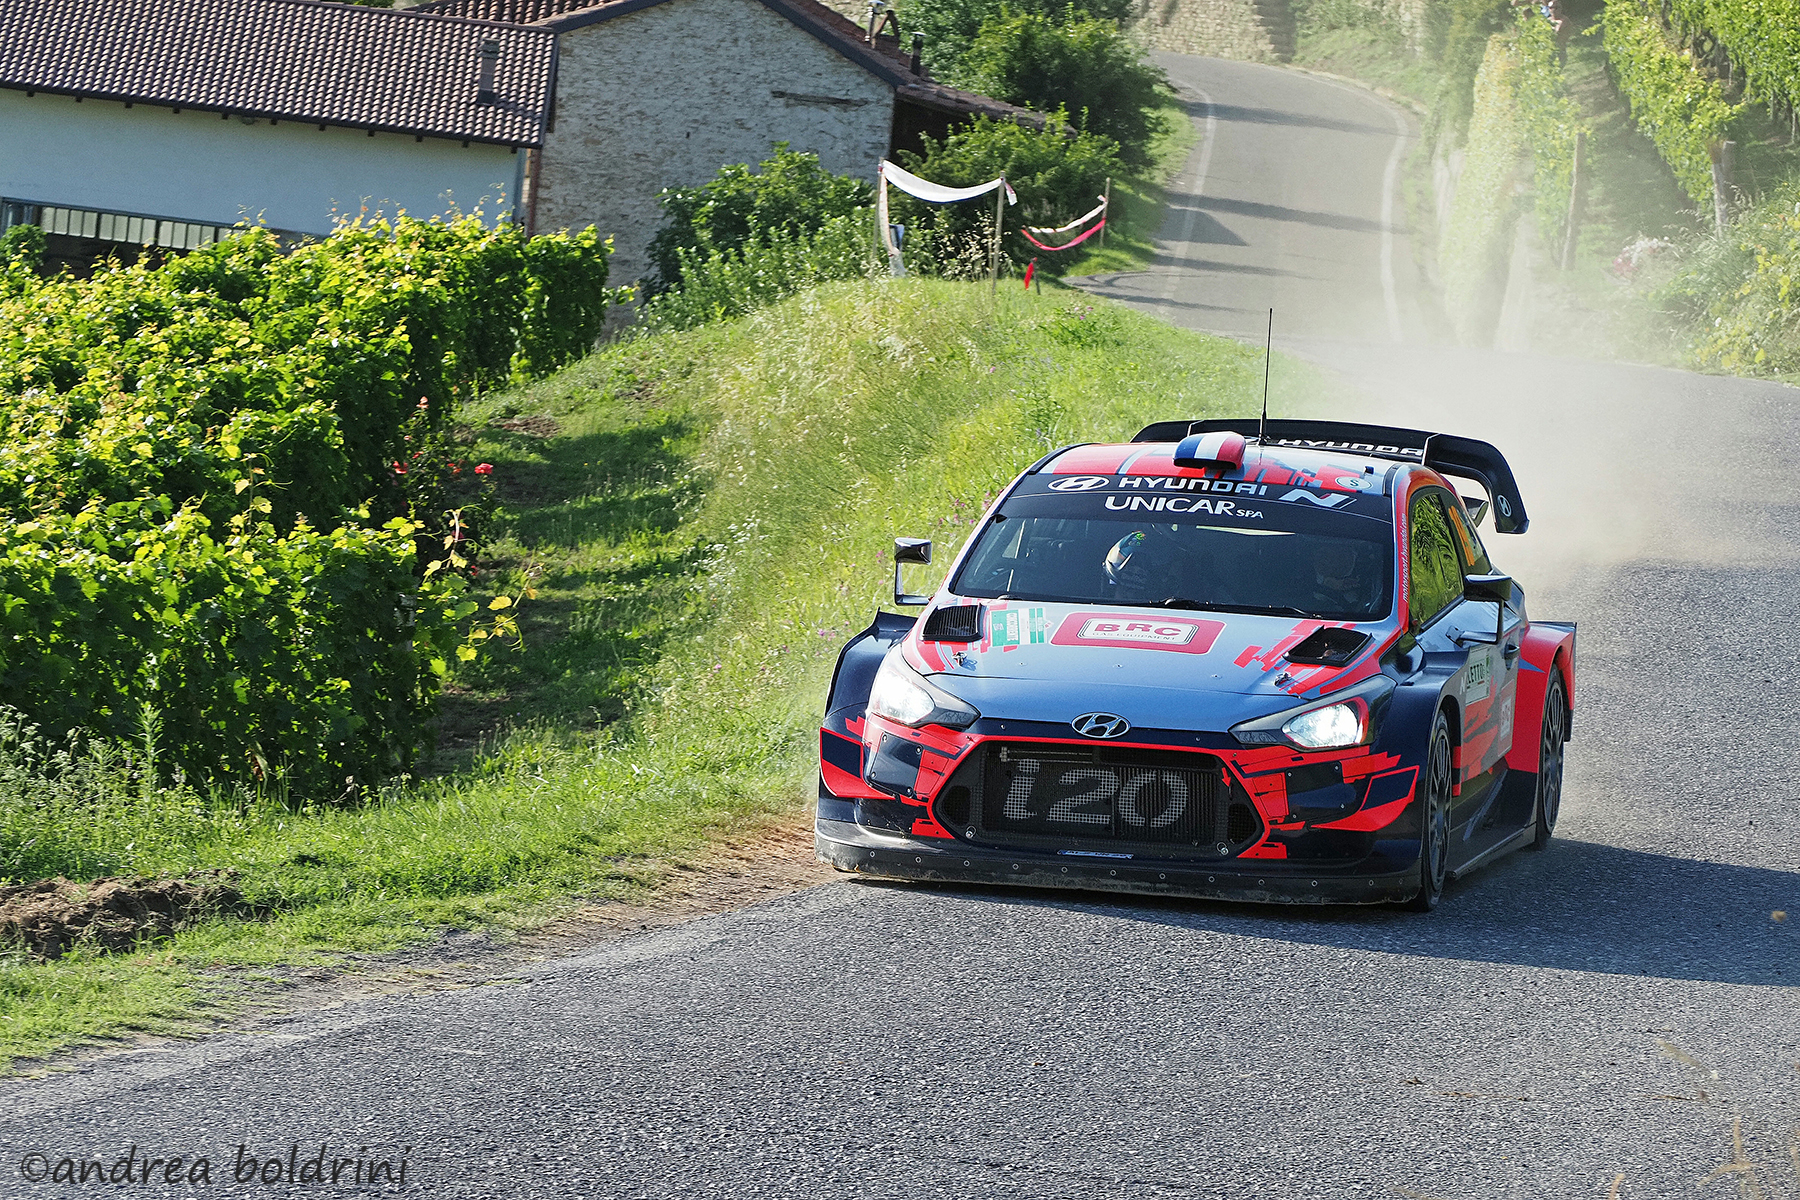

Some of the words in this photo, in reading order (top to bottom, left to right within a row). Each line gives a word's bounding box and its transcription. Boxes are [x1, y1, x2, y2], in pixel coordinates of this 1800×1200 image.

[1277, 438, 1425, 456] HYUNDA
[1118, 476, 1268, 496] HYUNDAI
[1104, 495, 1236, 516] UNICAR
[1236, 508, 1264, 520] SPA
[1094, 623, 1182, 636] BRC
[1003, 758, 1189, 828] i20
